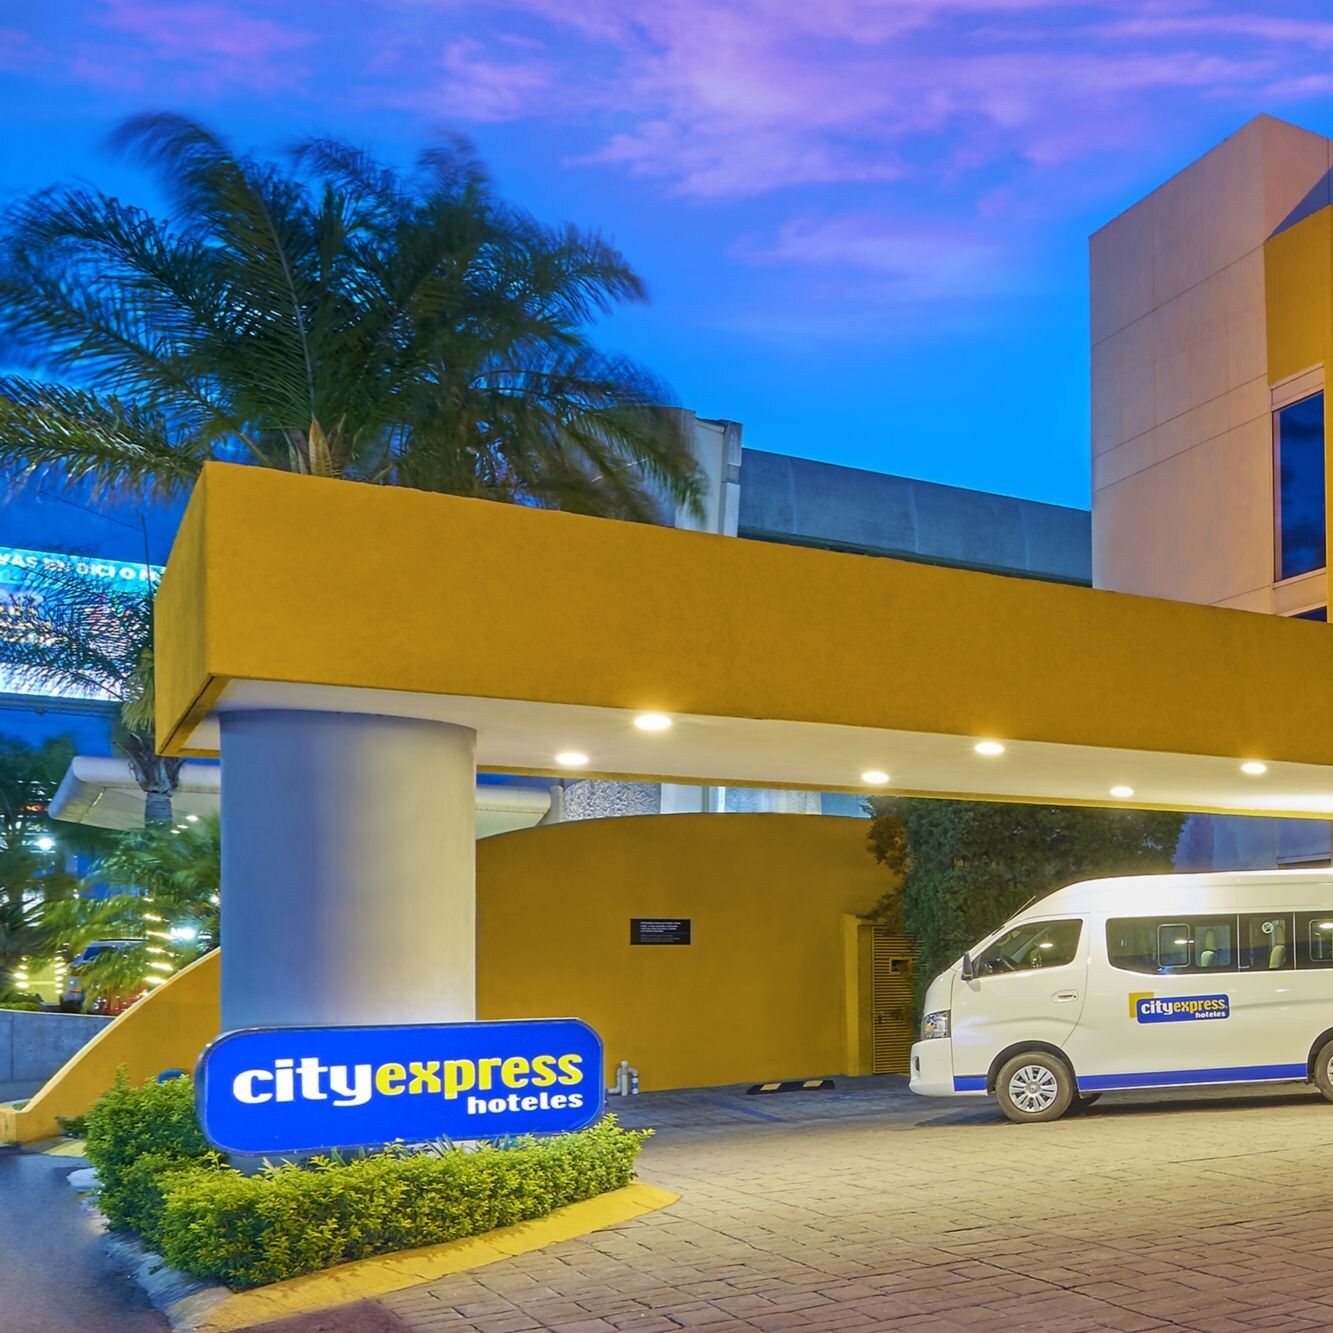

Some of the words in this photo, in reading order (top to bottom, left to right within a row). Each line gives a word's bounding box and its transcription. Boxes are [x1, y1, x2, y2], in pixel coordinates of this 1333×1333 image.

[1141, 999, 1226, 1015] cityexpress
[233, 1054, 584, 1107] cityexpress
[467, 1092, 584, 1115] hoteles
